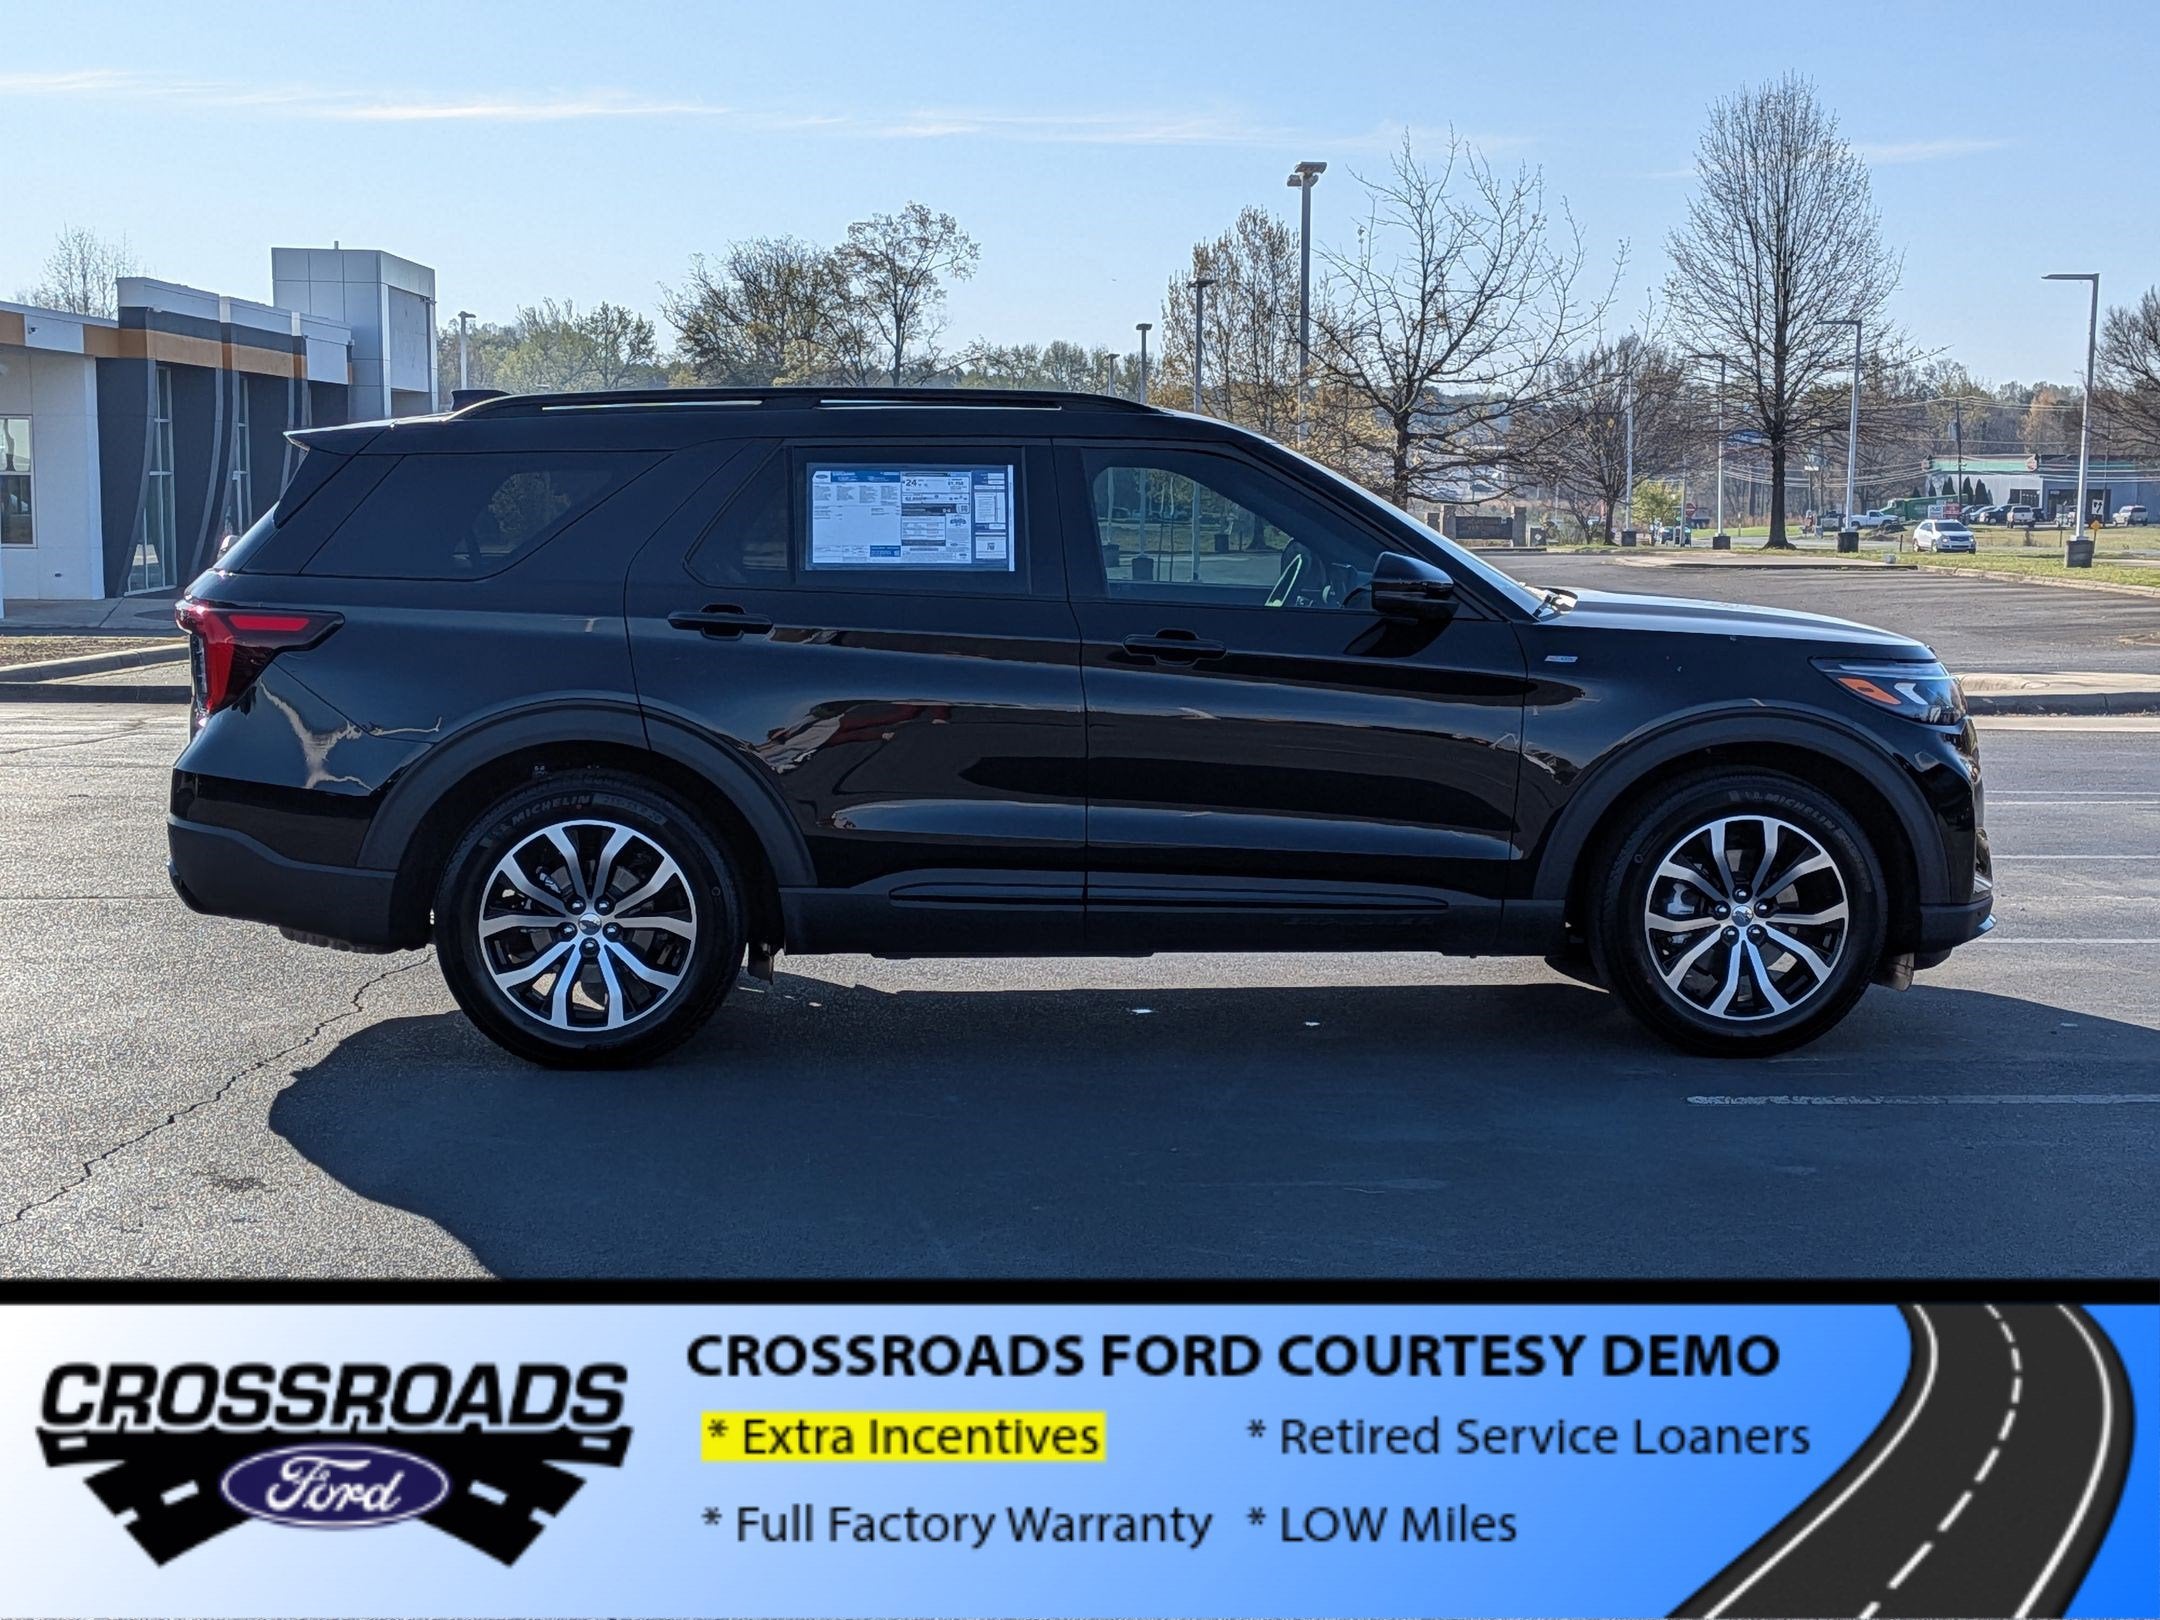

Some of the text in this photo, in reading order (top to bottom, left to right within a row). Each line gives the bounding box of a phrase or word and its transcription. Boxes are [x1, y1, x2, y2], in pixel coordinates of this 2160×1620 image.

[905, 479, 917, 487] 24
[512, 795, 591, 825] MICHELIN
[1767, 793, 1835, 829] MICHELIN
